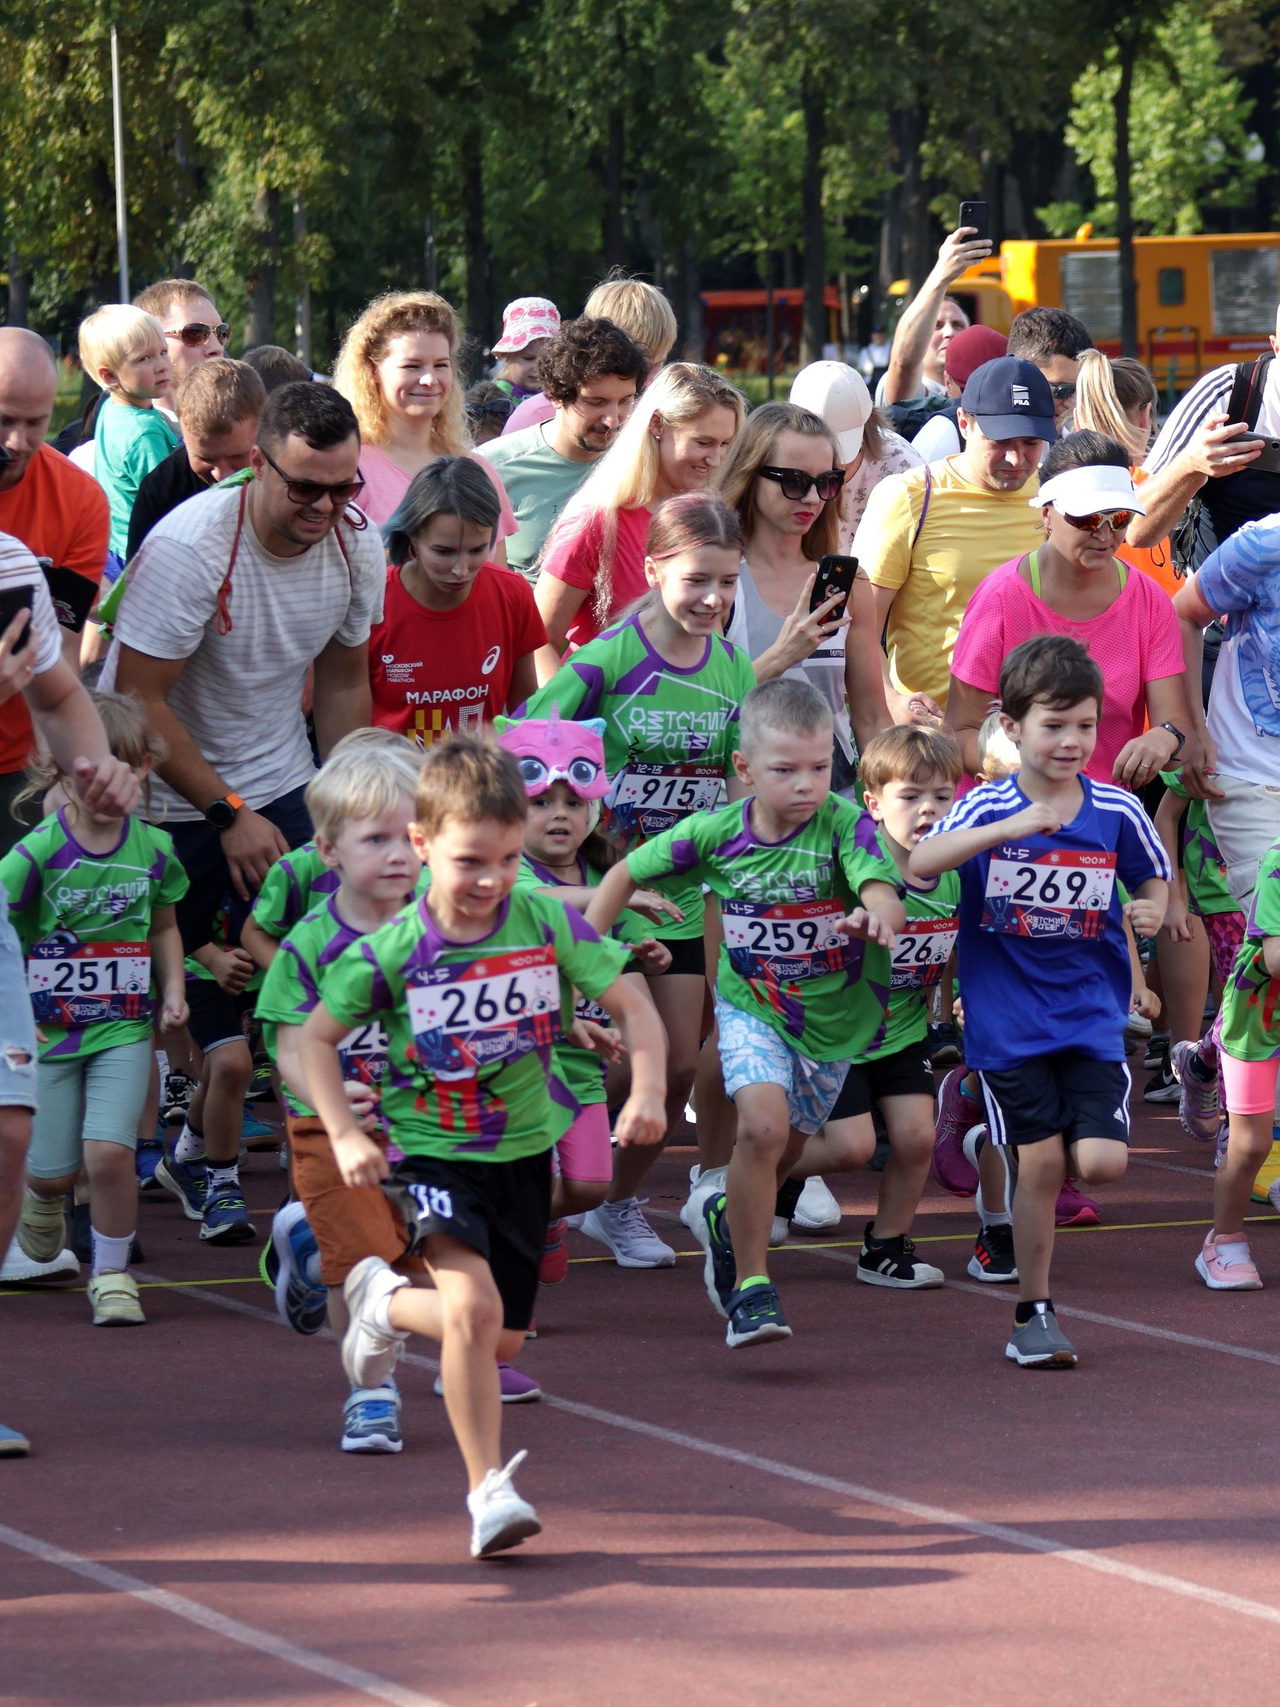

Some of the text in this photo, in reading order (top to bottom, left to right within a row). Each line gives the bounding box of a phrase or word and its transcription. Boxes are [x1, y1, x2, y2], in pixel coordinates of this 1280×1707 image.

[406, 683, 489, 705] МАРАФОН
[636, 764, 664, 775] 12-13
[639, 778, 700, 807] 915
[1002, 846, 1030, 860] 4-5
[1012, 866, 1087, 905] 269
[729, 902, 755, 915] 4-5
[747, 920, 818, 953] 259
[892, 936, 934, 964] 26
[39, 946, 65, 957] 4-5
[53, 960, 119, 993] 251
[416, 967, 450, 983] 4-5
[441, 976, 527, 1029] 266
[350, 1020, 388, 1050] 25
